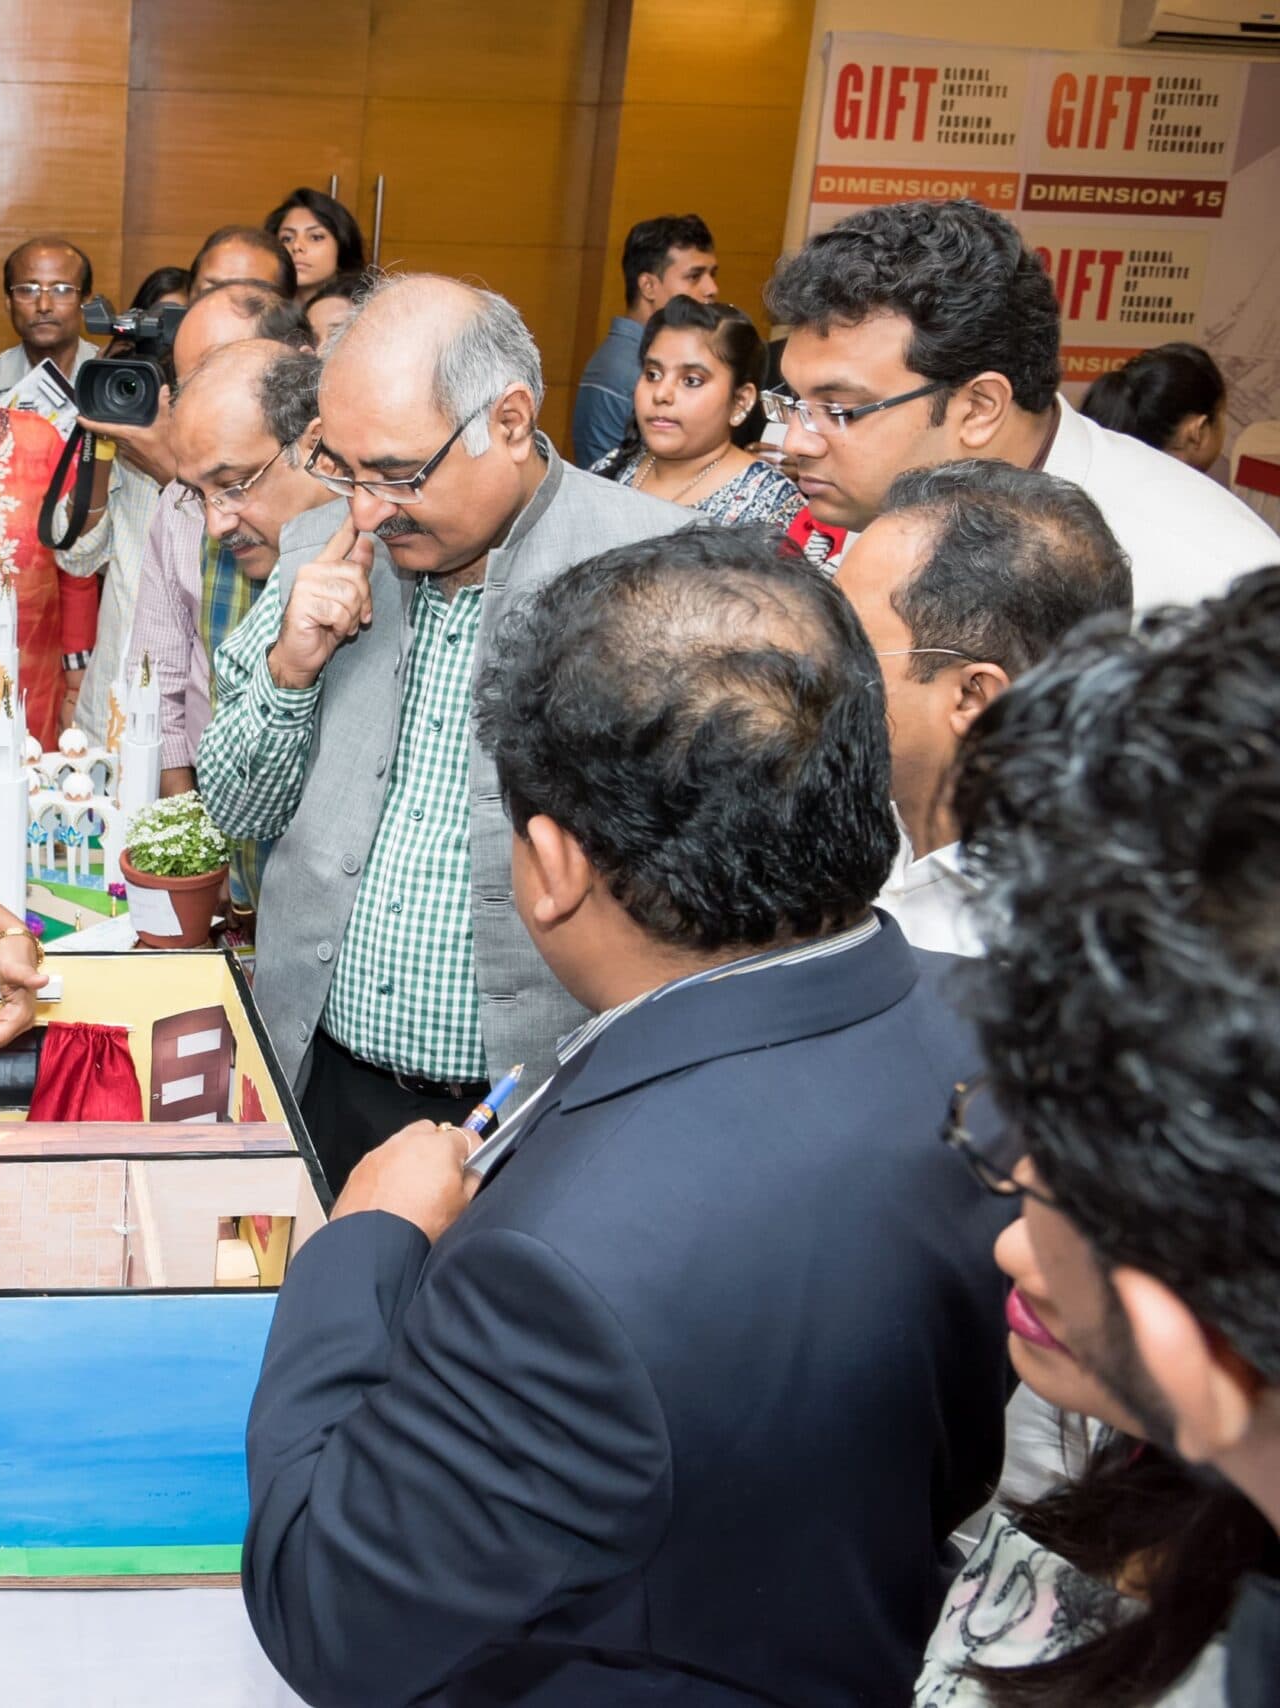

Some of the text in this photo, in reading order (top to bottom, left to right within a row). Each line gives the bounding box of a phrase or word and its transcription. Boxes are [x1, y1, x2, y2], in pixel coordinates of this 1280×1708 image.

[944, 67, 990, 82] GLOBAL
[942, 83, 1008, 98] INSTITUTE
[1157, 76, 1201, 91] GLOBAL
[834, 62, 939, 142] GIFT
[940, 100, 954, 112] OF
[1154, 93, 1219, 107] INSTITUTE
[1046, 72, 1152, 150] GIFT
[1152, 109, 1166, 121] OF
[938, 115, 992, 129] FASHION
[937, 130, 1016, 146] TECHNOLOGY
[1149, 124, 1202, 138] FASHION
[1147, 139, 1224, 155] TECHNOLOGY
[985, 183, 1015, 199] 15
[1193, 190, 1222, 207] 15
[1129, 250, 1173, 263] GLOBAL
[1126, 265, 1190, 279] INSTITUTE
[1124, 280, 1138, 293] OF
[1121, 296, 1173, 308] FASHION
[1120, 310, 1195, 325] TECHNOLOGY
